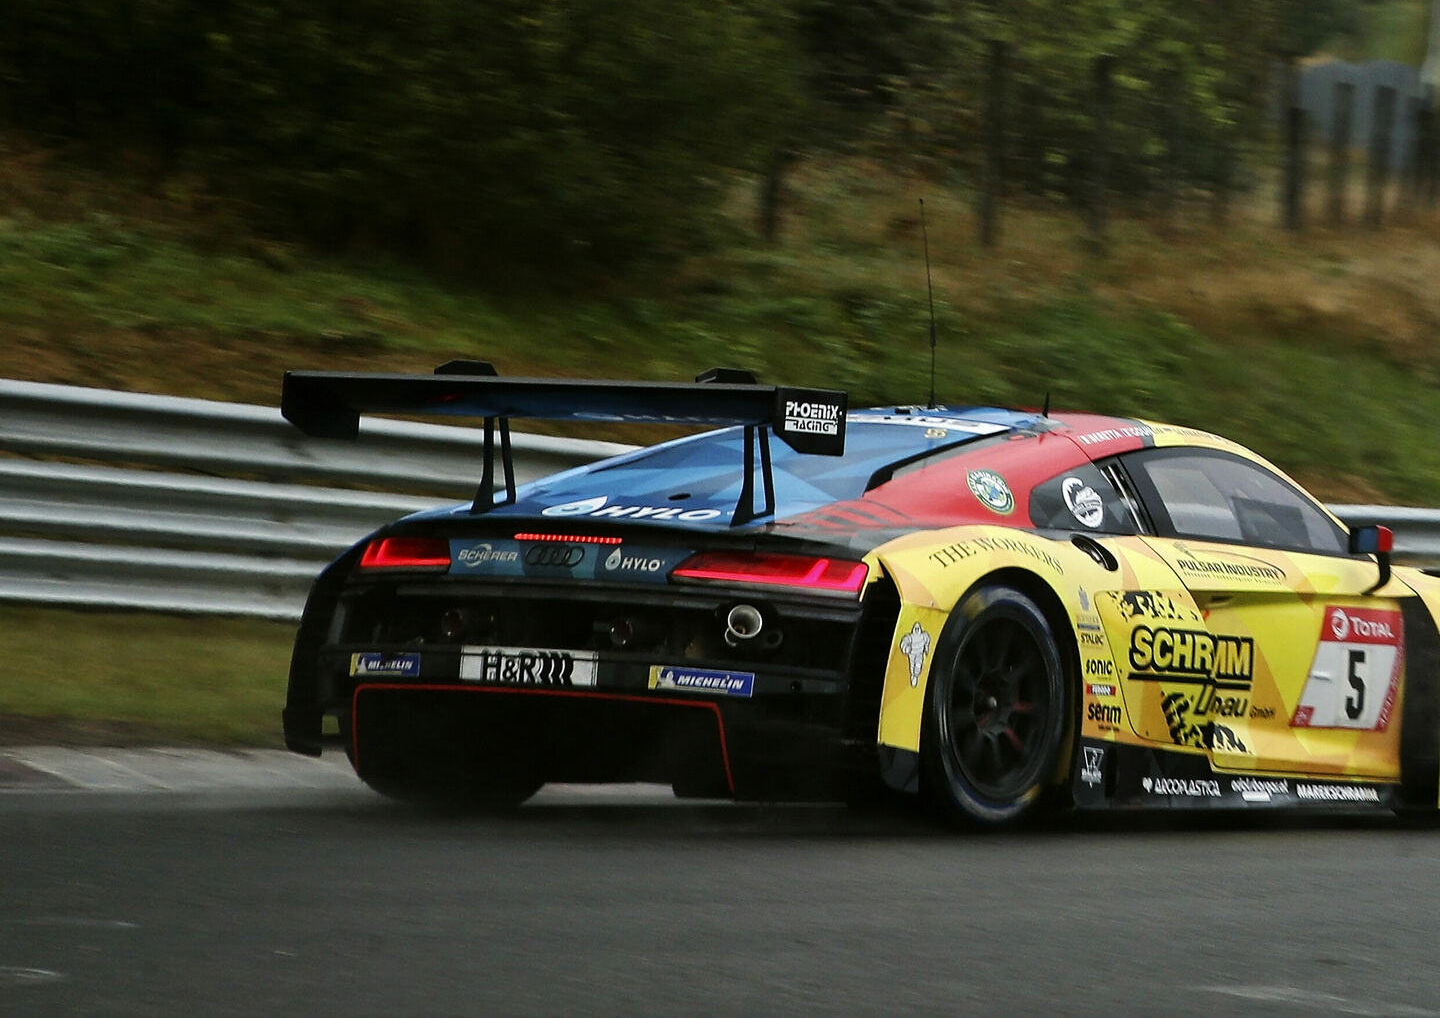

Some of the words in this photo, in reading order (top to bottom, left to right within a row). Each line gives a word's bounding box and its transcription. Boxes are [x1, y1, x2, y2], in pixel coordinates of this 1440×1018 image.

[590, 505, 721, 521] HYLO
[621, 557, 661, 571] HYLO
[929, 541, 976, 568] THE
[972, 538, 1064, 574] WORKERS
[1350, 616, 1394, 638] TOTAL
[677, 675, 744, 690] MICHELIN
[1345, 649, 1366, 719] 5
